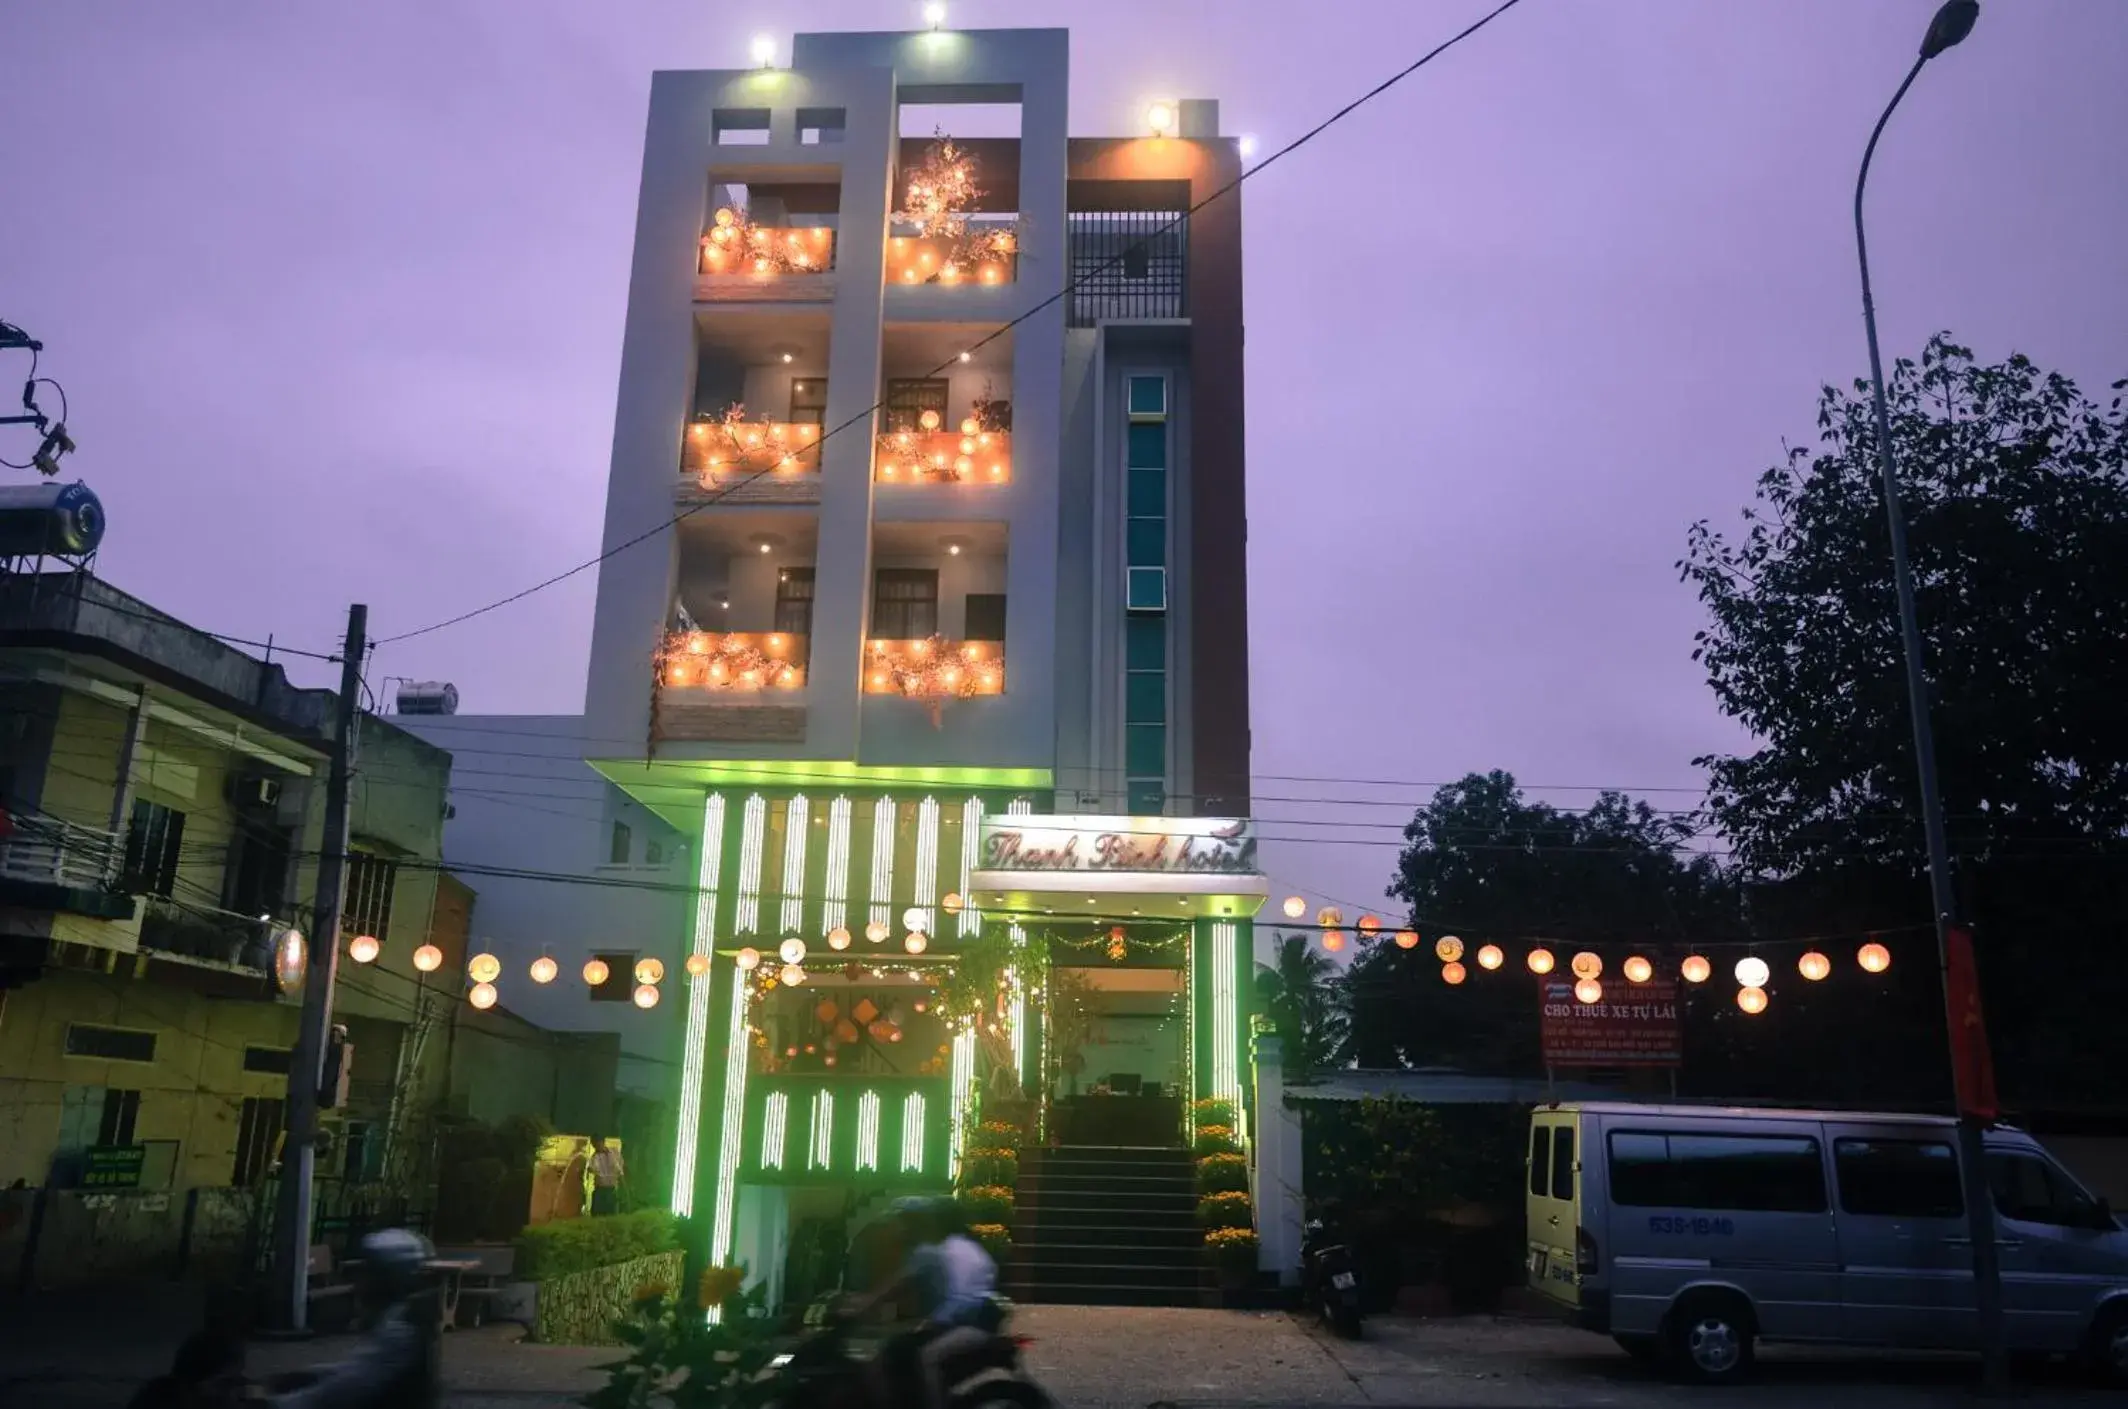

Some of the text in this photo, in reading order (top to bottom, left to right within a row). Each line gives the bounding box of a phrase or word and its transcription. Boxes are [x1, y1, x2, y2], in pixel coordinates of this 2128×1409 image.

[986, 831, 1079, 869] Thanh
[1173, 834, 1258, 869] hotel
[1544, 1004, 1571, 1018] CHO
[1612, 1005, 1631, 1019] XE
